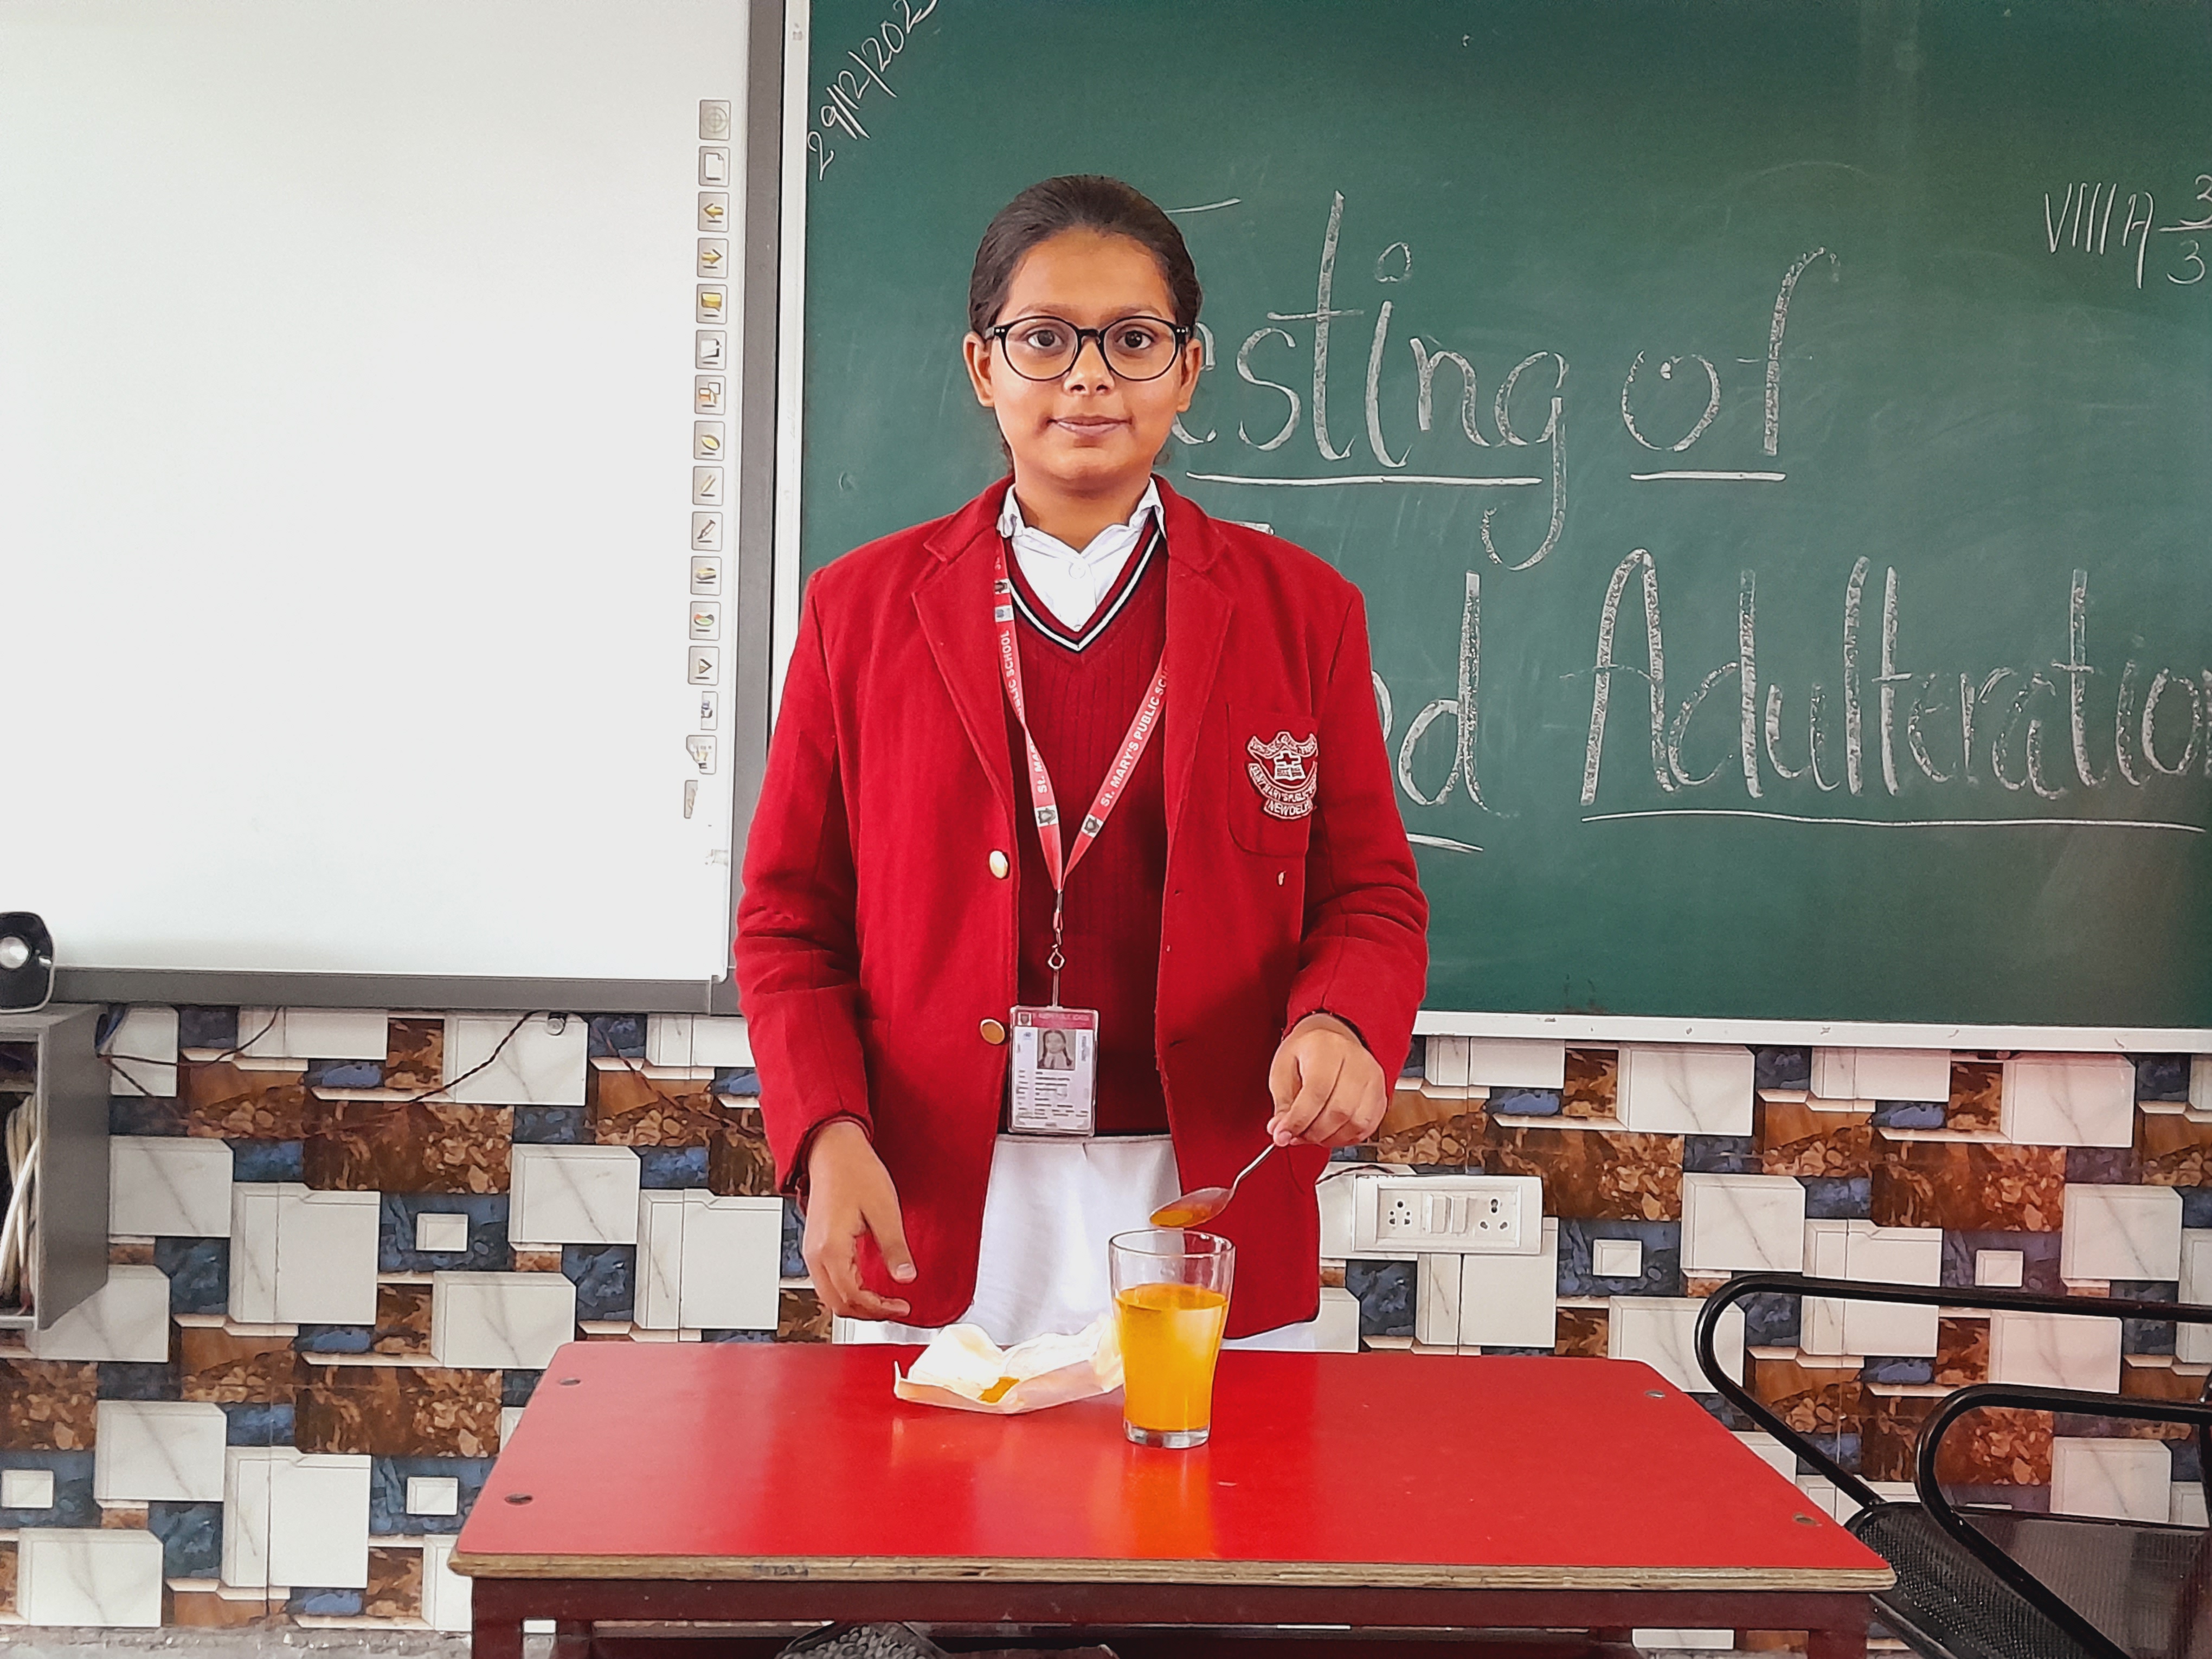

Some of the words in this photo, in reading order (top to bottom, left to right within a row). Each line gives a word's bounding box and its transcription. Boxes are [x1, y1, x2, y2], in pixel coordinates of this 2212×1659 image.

[1622, 246, 1841, 456] of
[1000, 630, 1014, 678] SCHOOL
[1100, 789, 1115, 807] St.
[1110, 741, 1139, 789] MARY'S
[1133, 696, 1160, 741] PUBLIC
